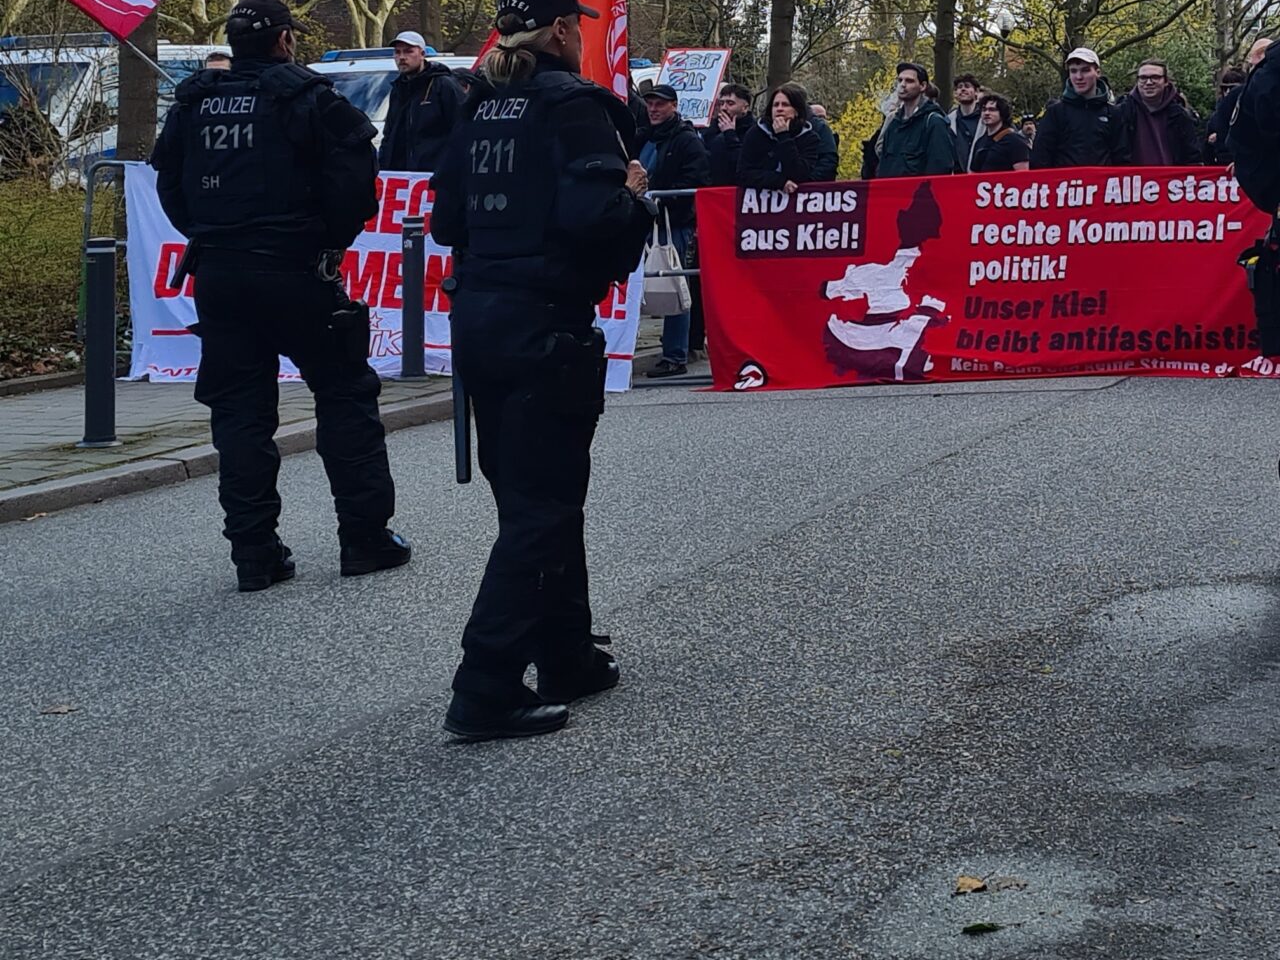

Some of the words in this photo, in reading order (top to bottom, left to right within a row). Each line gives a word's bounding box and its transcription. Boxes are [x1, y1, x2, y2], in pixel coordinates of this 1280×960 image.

[200, 96, 256, 115] POLIZEI
[473, 98, 529, 121] POLIZEI
[200, 123, 254, 150] 1211
[470, 139, 515, 174] 1211
[201, 176, 220, 189] SH
[975, 182, 1049, 209] Stadt
[1056, 180, 1097, 207] für
[1104, 176, 1159, 203] Alle
[1167, 175, 1240, 203] statt
[741, 188, 789, 214] AfD
[796, 190, 857, 213] raus
[741, 228, 790, 251] aus
[796, 222, 859, 251] Kiel!
[970, 220, 1061, 245] rechte
[1068, 214, 1242, 244] Kommunal-
[969, 255, 1067, 286] politik!
[964, 295, 1044, 320] Unser
[1051, 290, 1108, 318] Kiel
[956, 328, 1041, 353] bleibt
[1047, 324, 1261, 352] antifaschistis
[951, 357, 989, 372] Kein
[1140, 358, 1211, 373] Stimme
